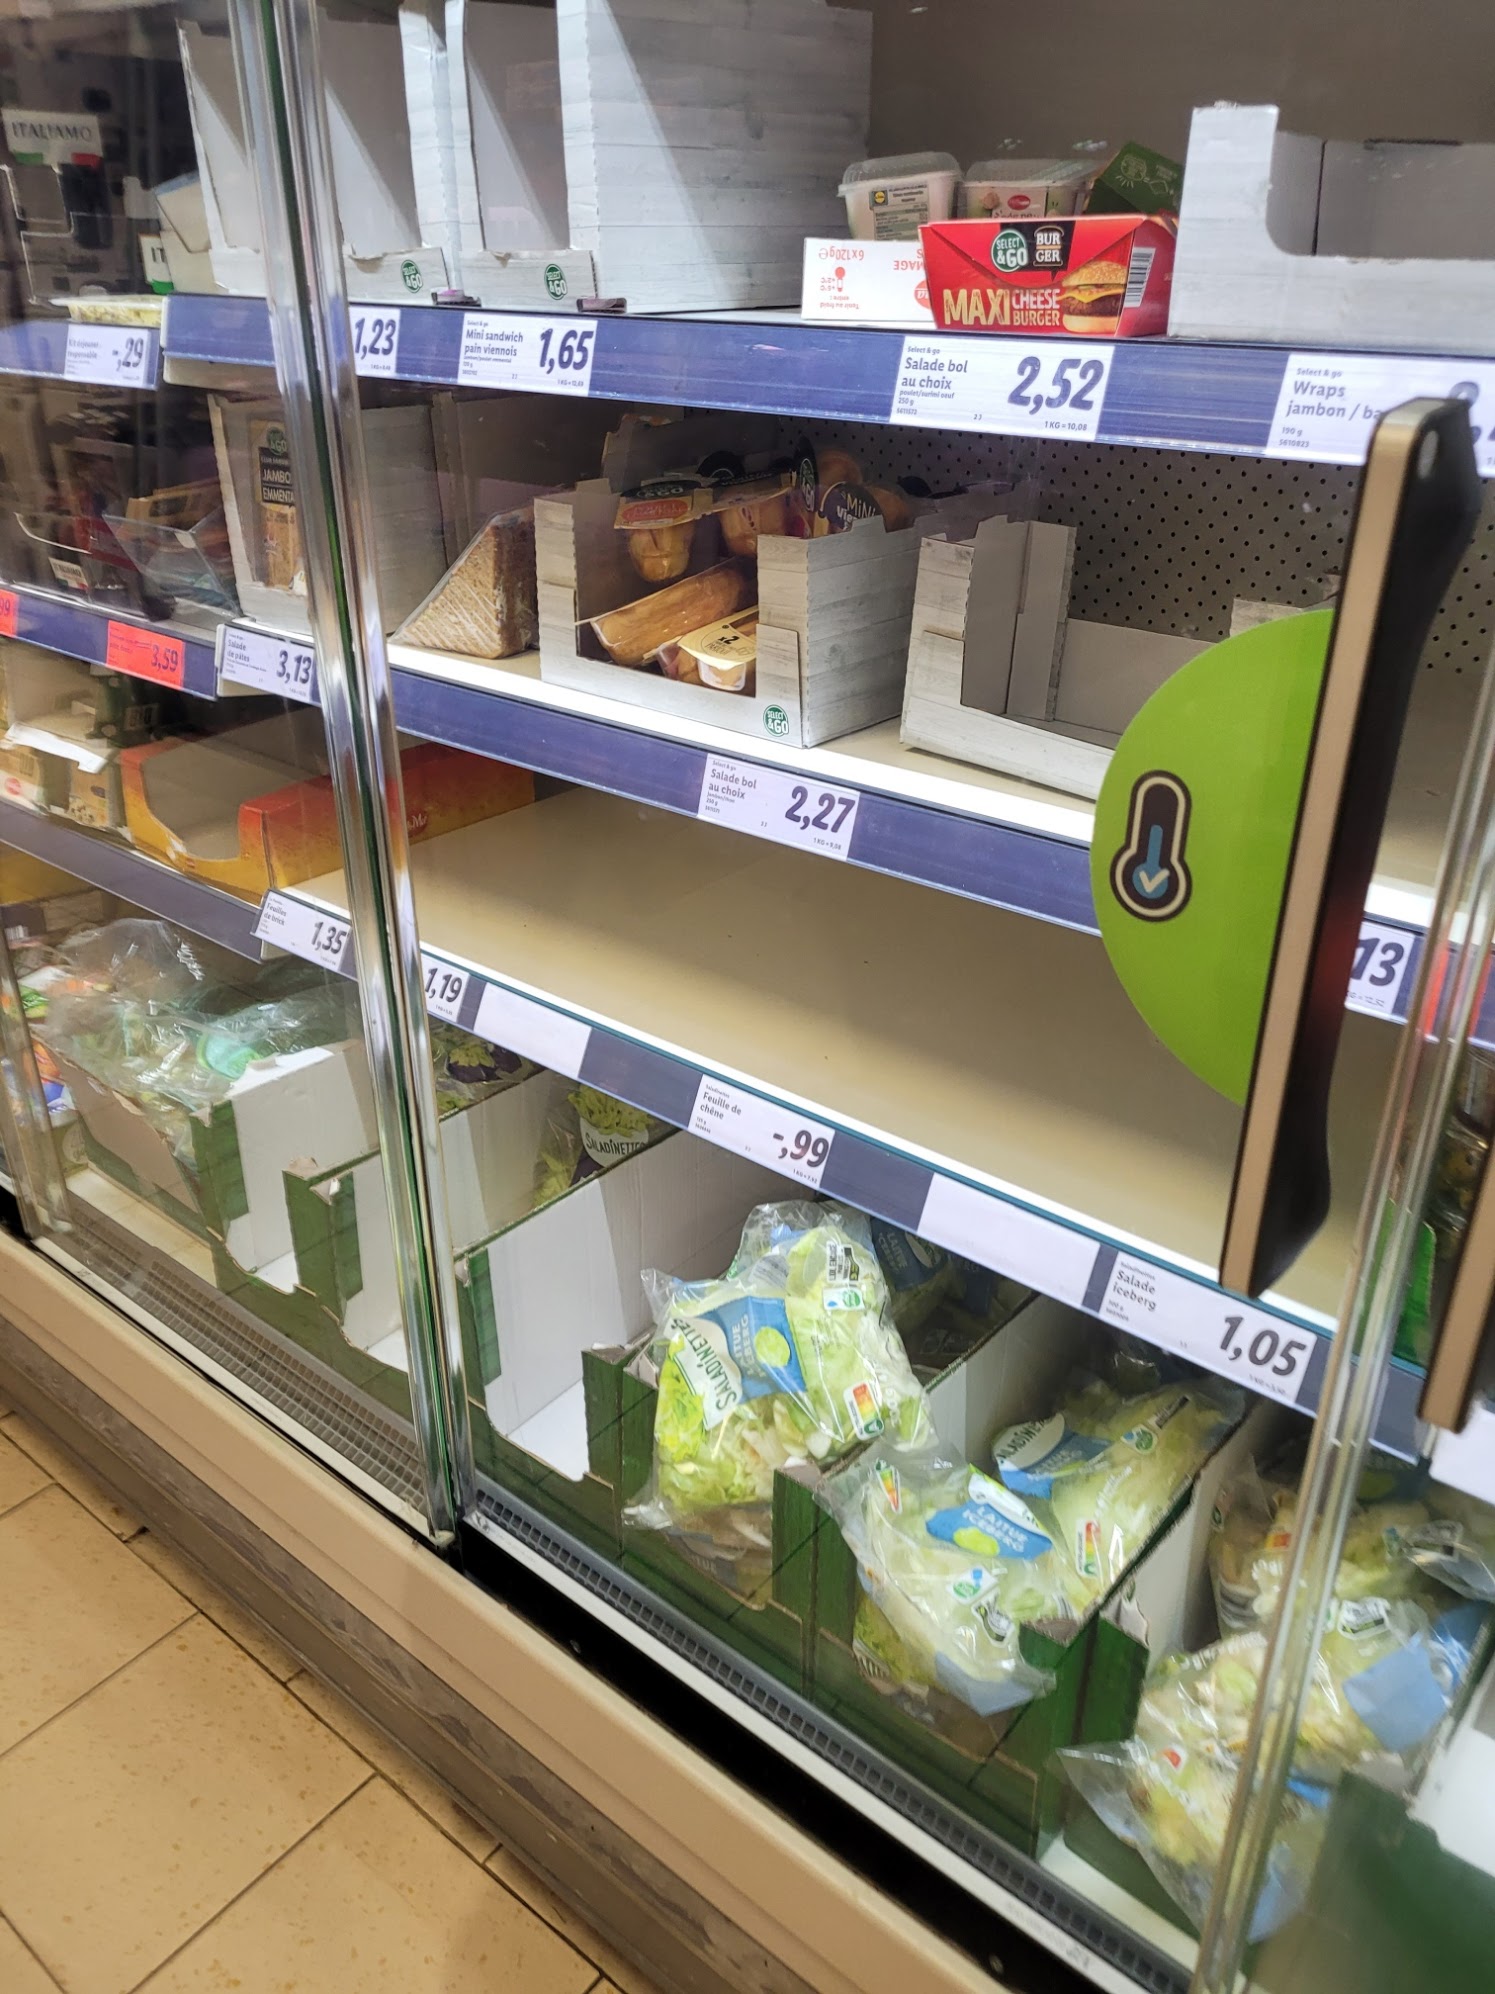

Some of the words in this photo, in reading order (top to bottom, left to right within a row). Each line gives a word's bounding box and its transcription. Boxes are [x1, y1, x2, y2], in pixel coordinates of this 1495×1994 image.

[12, 122, 92, 142] ITALIAMO
[996, 237, 1020, 250] SELECT
[1036, 232, 1061, 246] BUR
[893, 260, 924, 270] MAGE
[997, 248, 1028, 268] &GO
[1036, 249, 1061, 262] GER
[943, 288, 1010, 326] MAXI
[1012, 288, 1060, 308] CHEESE
[1012, 310, 1060, 326] BURGER
[354, 318, 396, 360] 1,23
[466, 329, 484, 340] Mini
[485, 331, 524, 342] sandwich
[112, 338, 144, 372] -,29
[464, 344, 482, 354] pain
[484, 344, 518, 356] viennois
[539, 328, 594, 374] 1,65
[908, 346, 926, 354] Select
[904, 357, 944, 372] Salade
[948, 359, 968, 373] bol
[1296, 368, 1322, 376] Select
[902, 377, 916, 387] au
[918, 376, 952, 390] choix
[1008, 356, 1104, 415] 2,52
[1293, 380, 1346, 398] Wraps
[1286, 400, 1346, 418] jambon
[1348, 403, 1361, 421] /
[1363, 406, 1383, 420] ba
[1050, 421, 1060, 429] KG
[1068, 422, 1088, 431] 10,08
[1282, 426, 1295, 434] 190
[262, 468, 291, 484] JAMBO
[262, 487, 296, 502] EMMENTA
[718, 636, 740, 644] x2
[150, 644, 178, 672] 3,59
[276, 650, 312, 684] 3,13
[768, 710, 784, 721] SELECT
[768, 719, 789, 734] &GO
[710, 768, 740, 785] Salade
[742, 777, 757, 789] bol
[708, 782, 720, 792] au
[722, 784, 745, 800] choix
[785, 786, 856, 834] 2,27
[311, 922, 347, 954] 1,35
[1350, 938, 1404, 986] 13
[425, 968, 462, 1002] 1,19
[700, 1102, 724, 1120] chêne
[703, 1092, 730, 1110] Feuille
[731, 1104, 742, 1116] de
[773, 1130, 830, 1168] -,99
[1118, 1270, 1156, 1294] Salade
[1112, 1282, 1156, 1312] iceberg
[1219, 1314, 1307, 1376] 1,05
[671, 1318, 738, 1411] SALADINETTES
